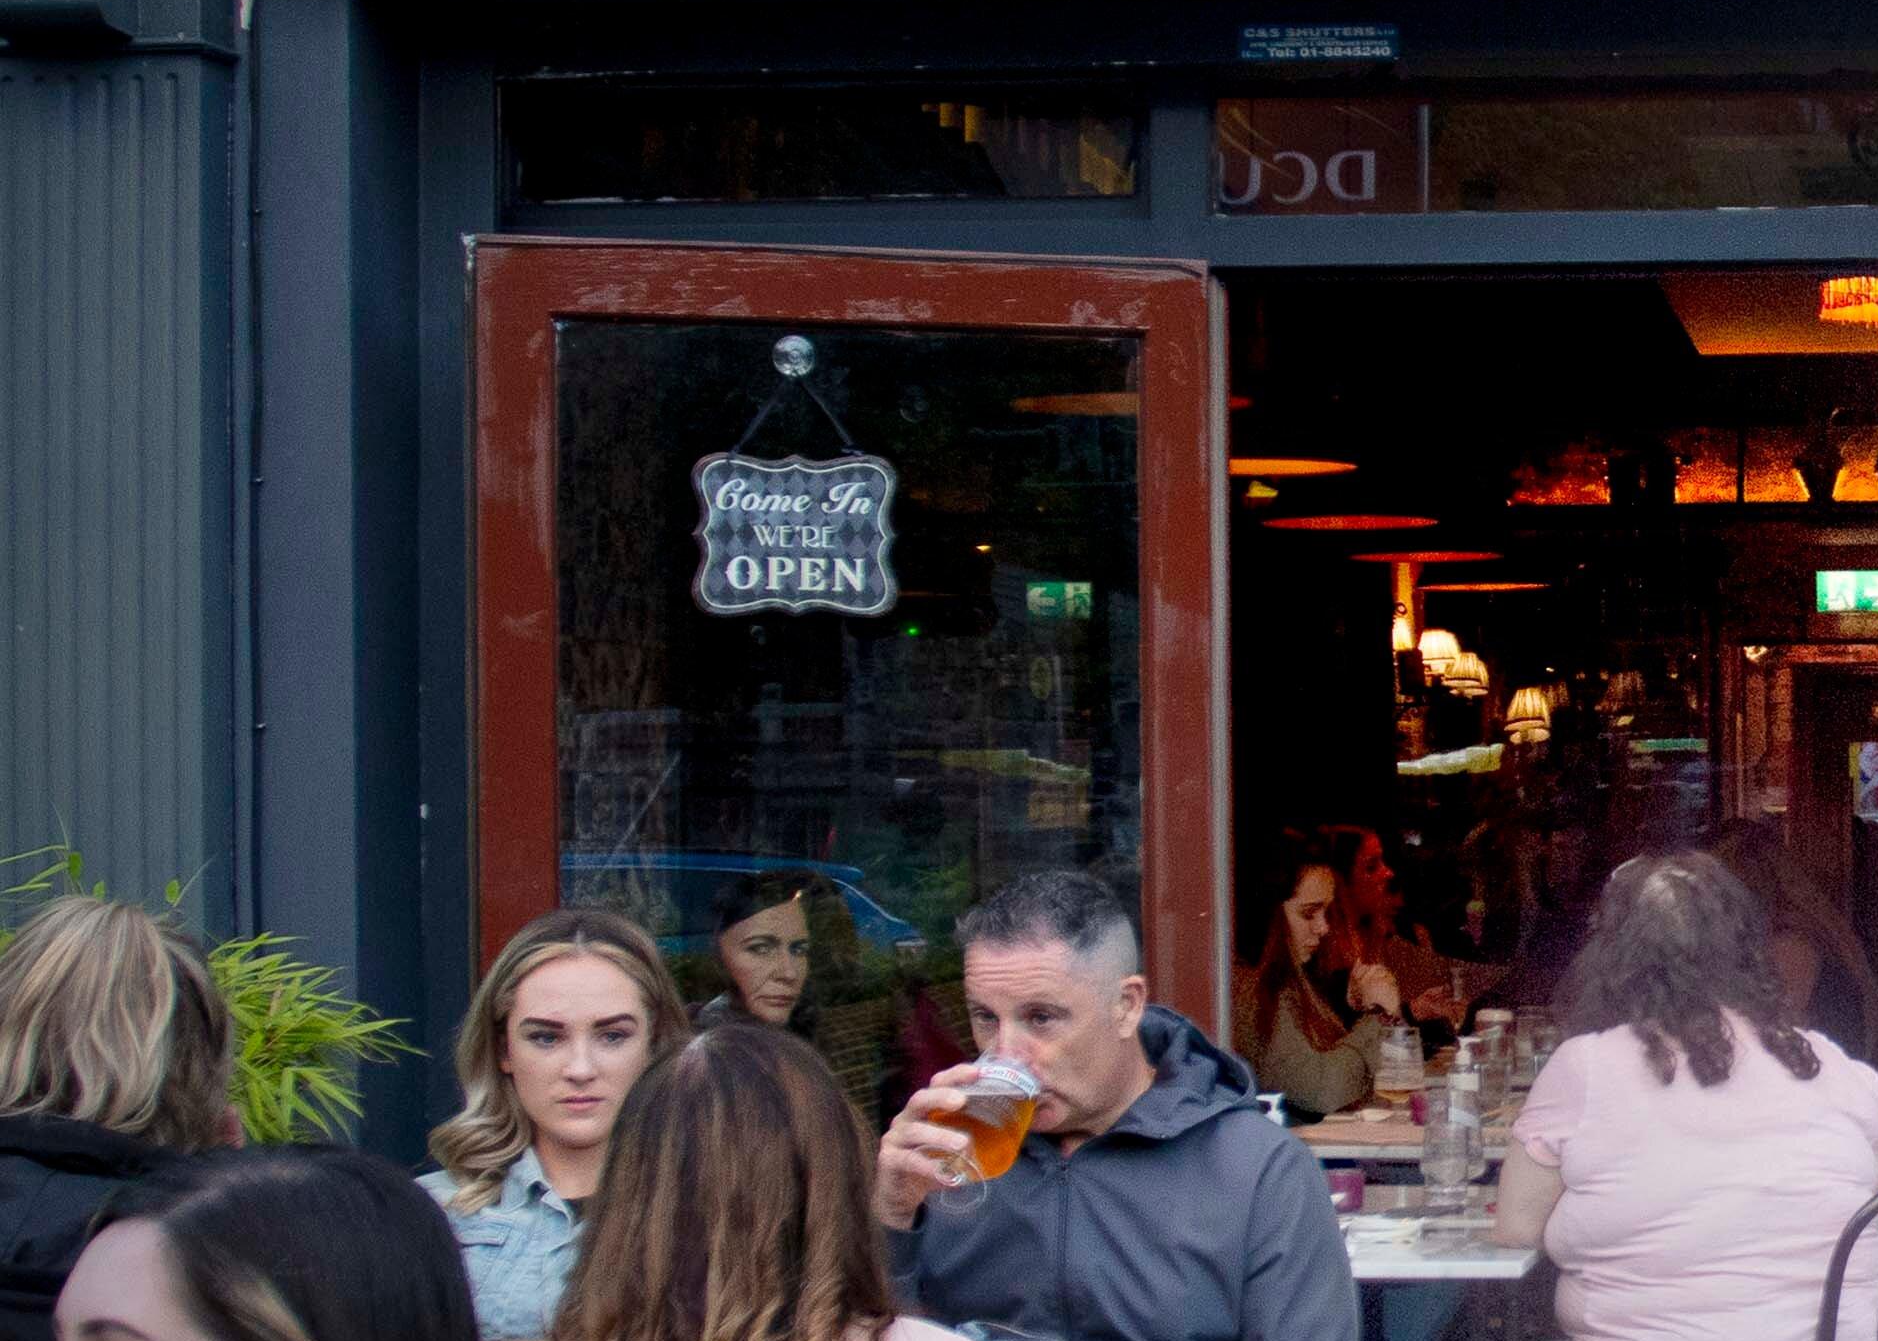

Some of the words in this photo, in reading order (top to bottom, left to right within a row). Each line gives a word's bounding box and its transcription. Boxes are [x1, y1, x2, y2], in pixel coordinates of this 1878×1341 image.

[1285, 26, 1376, 37] SHUTTERS
[715, 477, 811, 513] Come
[821, 481, 872, 515] In
[752, 524, 838, 548] WE'RE
[725, 555, 867, 593] OPEN
